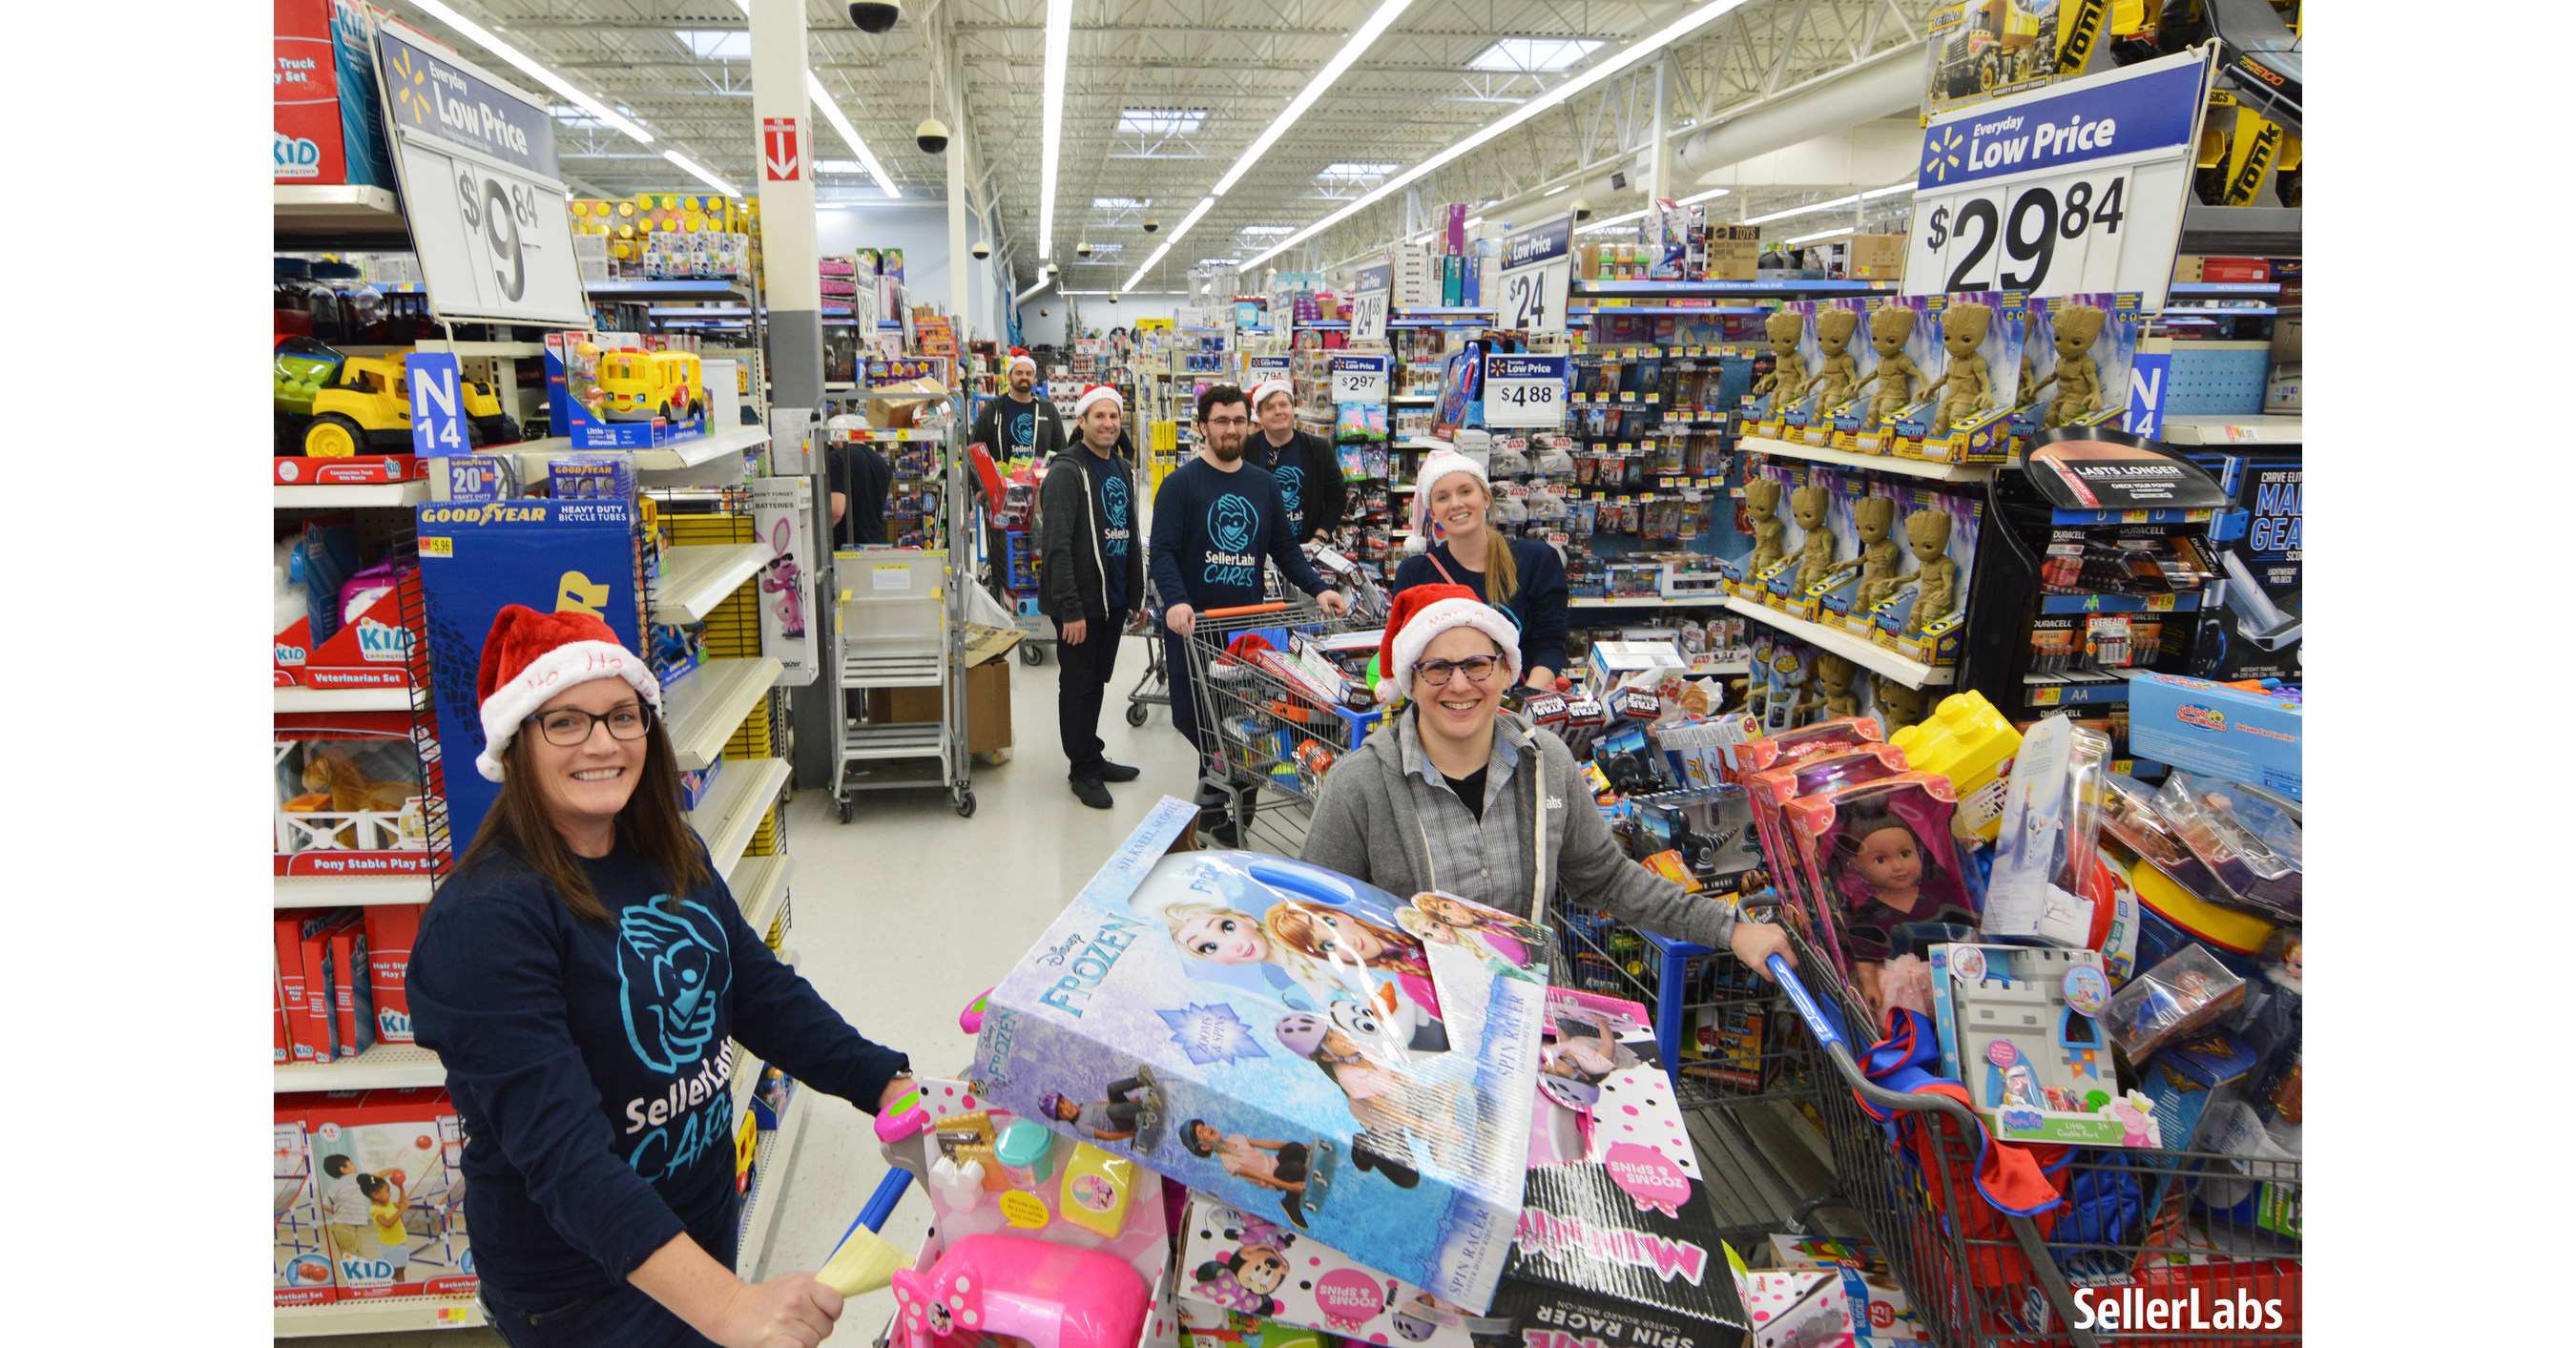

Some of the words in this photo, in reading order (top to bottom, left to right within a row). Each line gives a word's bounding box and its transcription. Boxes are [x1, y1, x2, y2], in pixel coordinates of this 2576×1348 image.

[1931, 10, 1962, 28] Tonka
[2059, 0, 2107, 69] Ton
[278, 57, 316, 70] Truck
[286, 72, 307, 83] Set
[427, 60, 467, 96] Everyday
[2028, 80, 2046, 89] TRUCK
[432, 80, 480, 136] Low
[479, 101, 529, 156] Price
[1972, 115, 2025, 137] Everyday
[1967, 136, 2027, 173] Low
[2031, 114, 2115, 160] Price
[1735, 228, 1755, 238] TOYS
[1513, 241, 1529, 261] Low
[1530, 235, 1550, 255] Price
[1507, 363, 1527, 373] Low
[1527, 363, 1551, 373] Price
[414, 367, 457, 417] N
[2125, 367, 2162, 411] N
[2122, 411, 2154, 439] 14
[416, 421, 461, 450] 14
[385, 461, 401, 473] KID
[2073, 466, 2122, 476] LASTS
[2124, 466, 2183, 475] LONGER
[2260, 471, 2287, 484] CARVE
[558, 513, 596, 522] BICYCLE
[598, 513, 627, 522] TUBES
[596, 505, 623, 513] DUTY
[2053, 530, 2086, 540] DURACELL
[1205, 550, 1256, 567] SellerLabs
[1203, 564, 1256, 588] CARES
[2267, 568, 2297, 576] LIGHTWEIGHT
[2088, 618, 2129, 628] EVEREADY
[360, 628, 413, 651] KID
[276, 648, 304, 660] KID
[314, 674, 381, 683] Veterinarian
[383, 674, 401, 683] Set
[2071, 690, 2088, 701] AA
[2177, 713, 2199, 725] Smart
[2199, 717, 2228, 732] Wheels
[2235, 723, 2258, 735] Deluxe
[2258, 728, 2271, 737] Car
[2271, 732, 2295, 742] Carrier
[314, 859, 344, 871] Pony
[348, 859, 387, 869] Stable
[390, 859, 417, 871] Play
[1036, 932, 1085, 966] Disney
[1038, 912, 1147, 1019] FROZEN
[1197, 1016, 1214, 1054] ZOOMS
[1217, 1015, 1227, 1045] SPINS
[294, 1046, 313, 1054] KID
[987, 1006, 1019, 1080] FROZEN
[2081, 1130, 2099, 1139] Fort
[1610, 1161, 1655, 1175] SPINS
[1628, 1173, 1684, 1189] ZOOMS
[1449, 1262, 1469, 1296] SPIN
[1463, 1209, 1489, 1259] RACER
[342, 1261, 392, 1279] KID
[1319, 1284, 1358, 1296] SPINS
[1328, 1296, 1378, 1308] ZOOMS
[1537, 1305, 1622, 1338] RACER
[1872, 1304, 1886, 1324] 75
